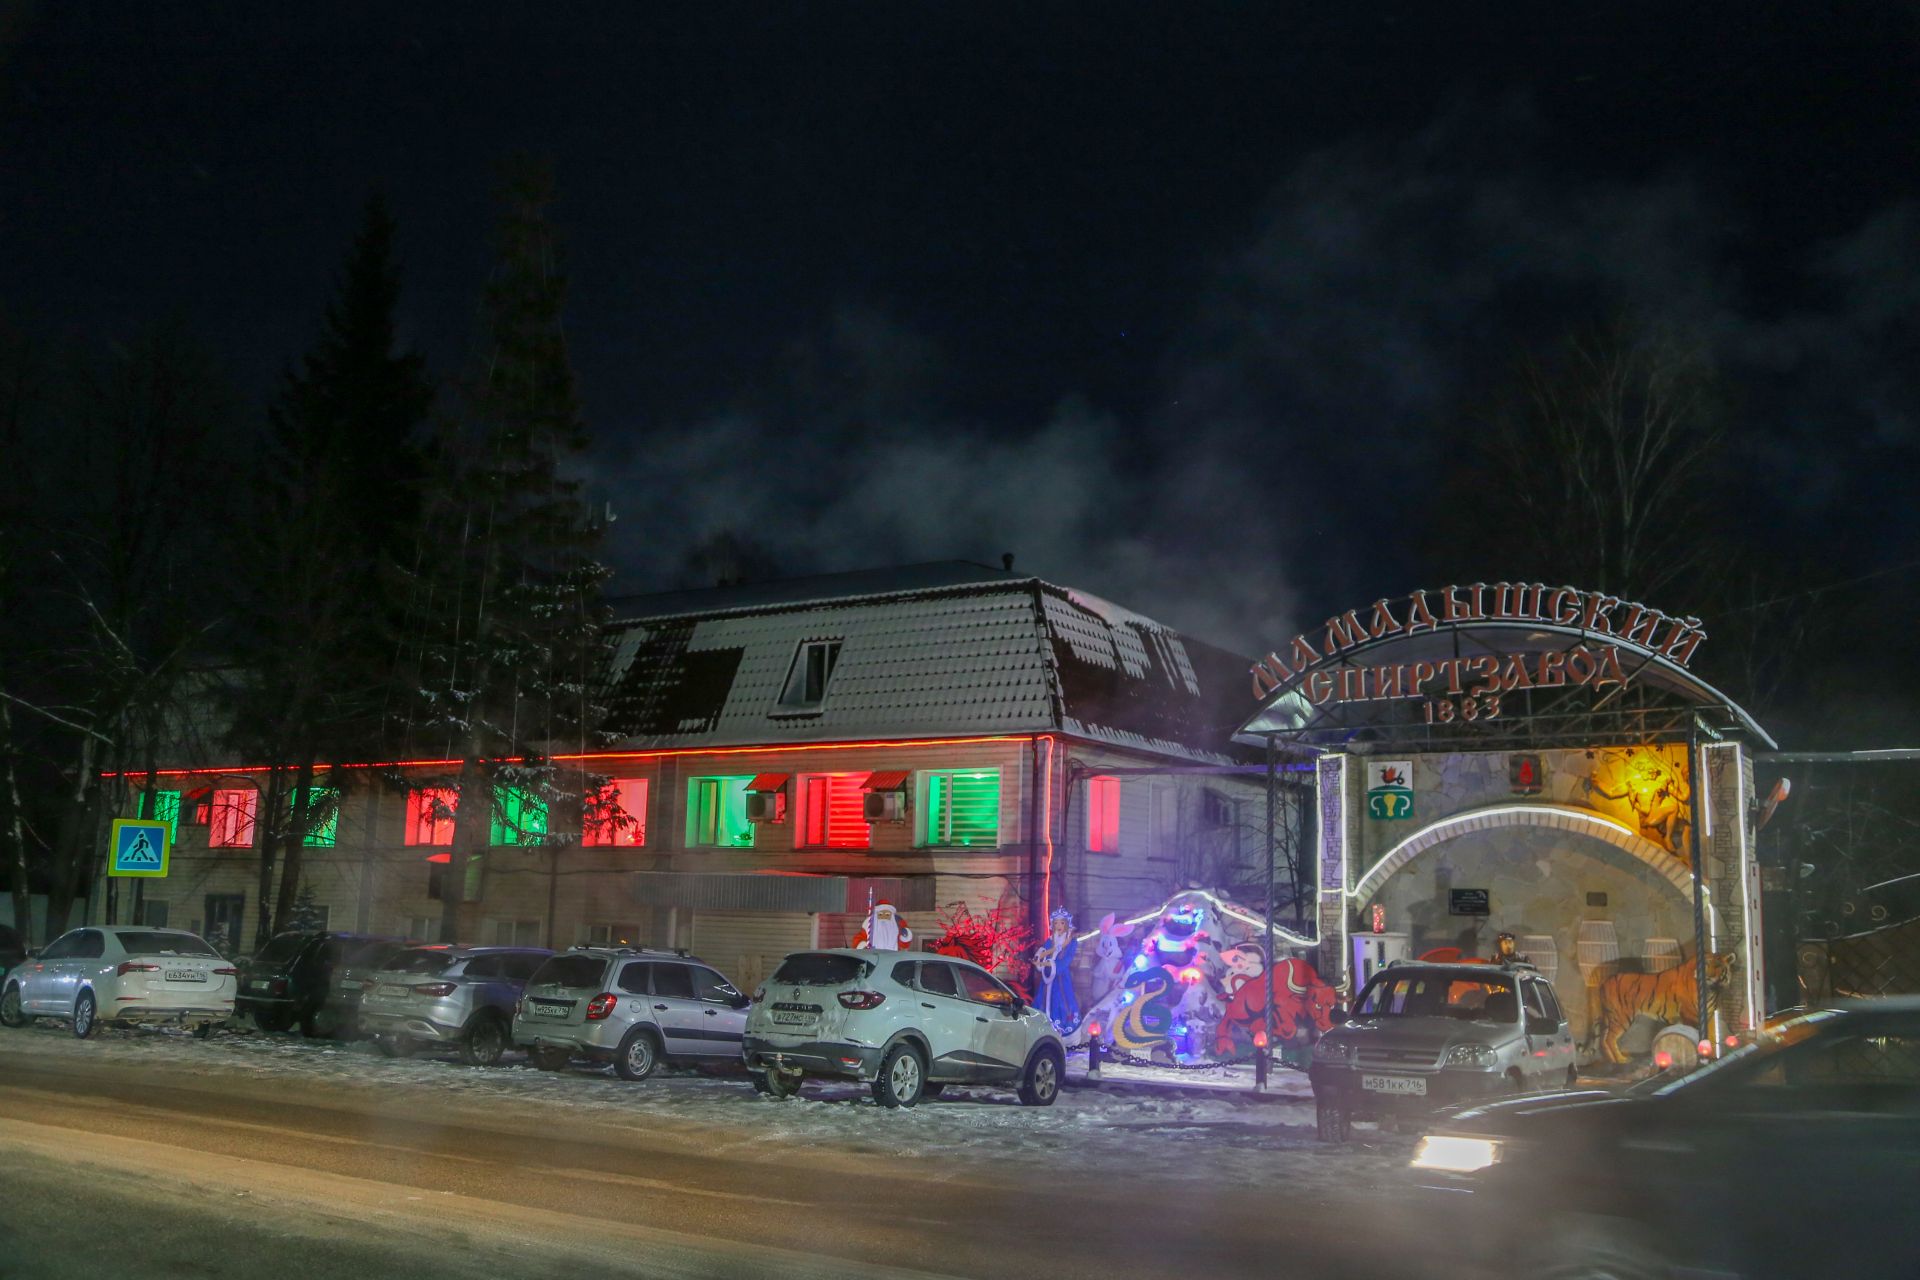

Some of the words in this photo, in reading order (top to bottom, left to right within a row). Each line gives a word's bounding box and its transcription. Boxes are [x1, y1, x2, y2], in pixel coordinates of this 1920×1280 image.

[1248, 582, 1708, 700] МАМАДЫШСКИЙ
[1301, 644, 1630, 705] СПИРТЗАВОД
[1422, 696, 1500, 724] 1883
